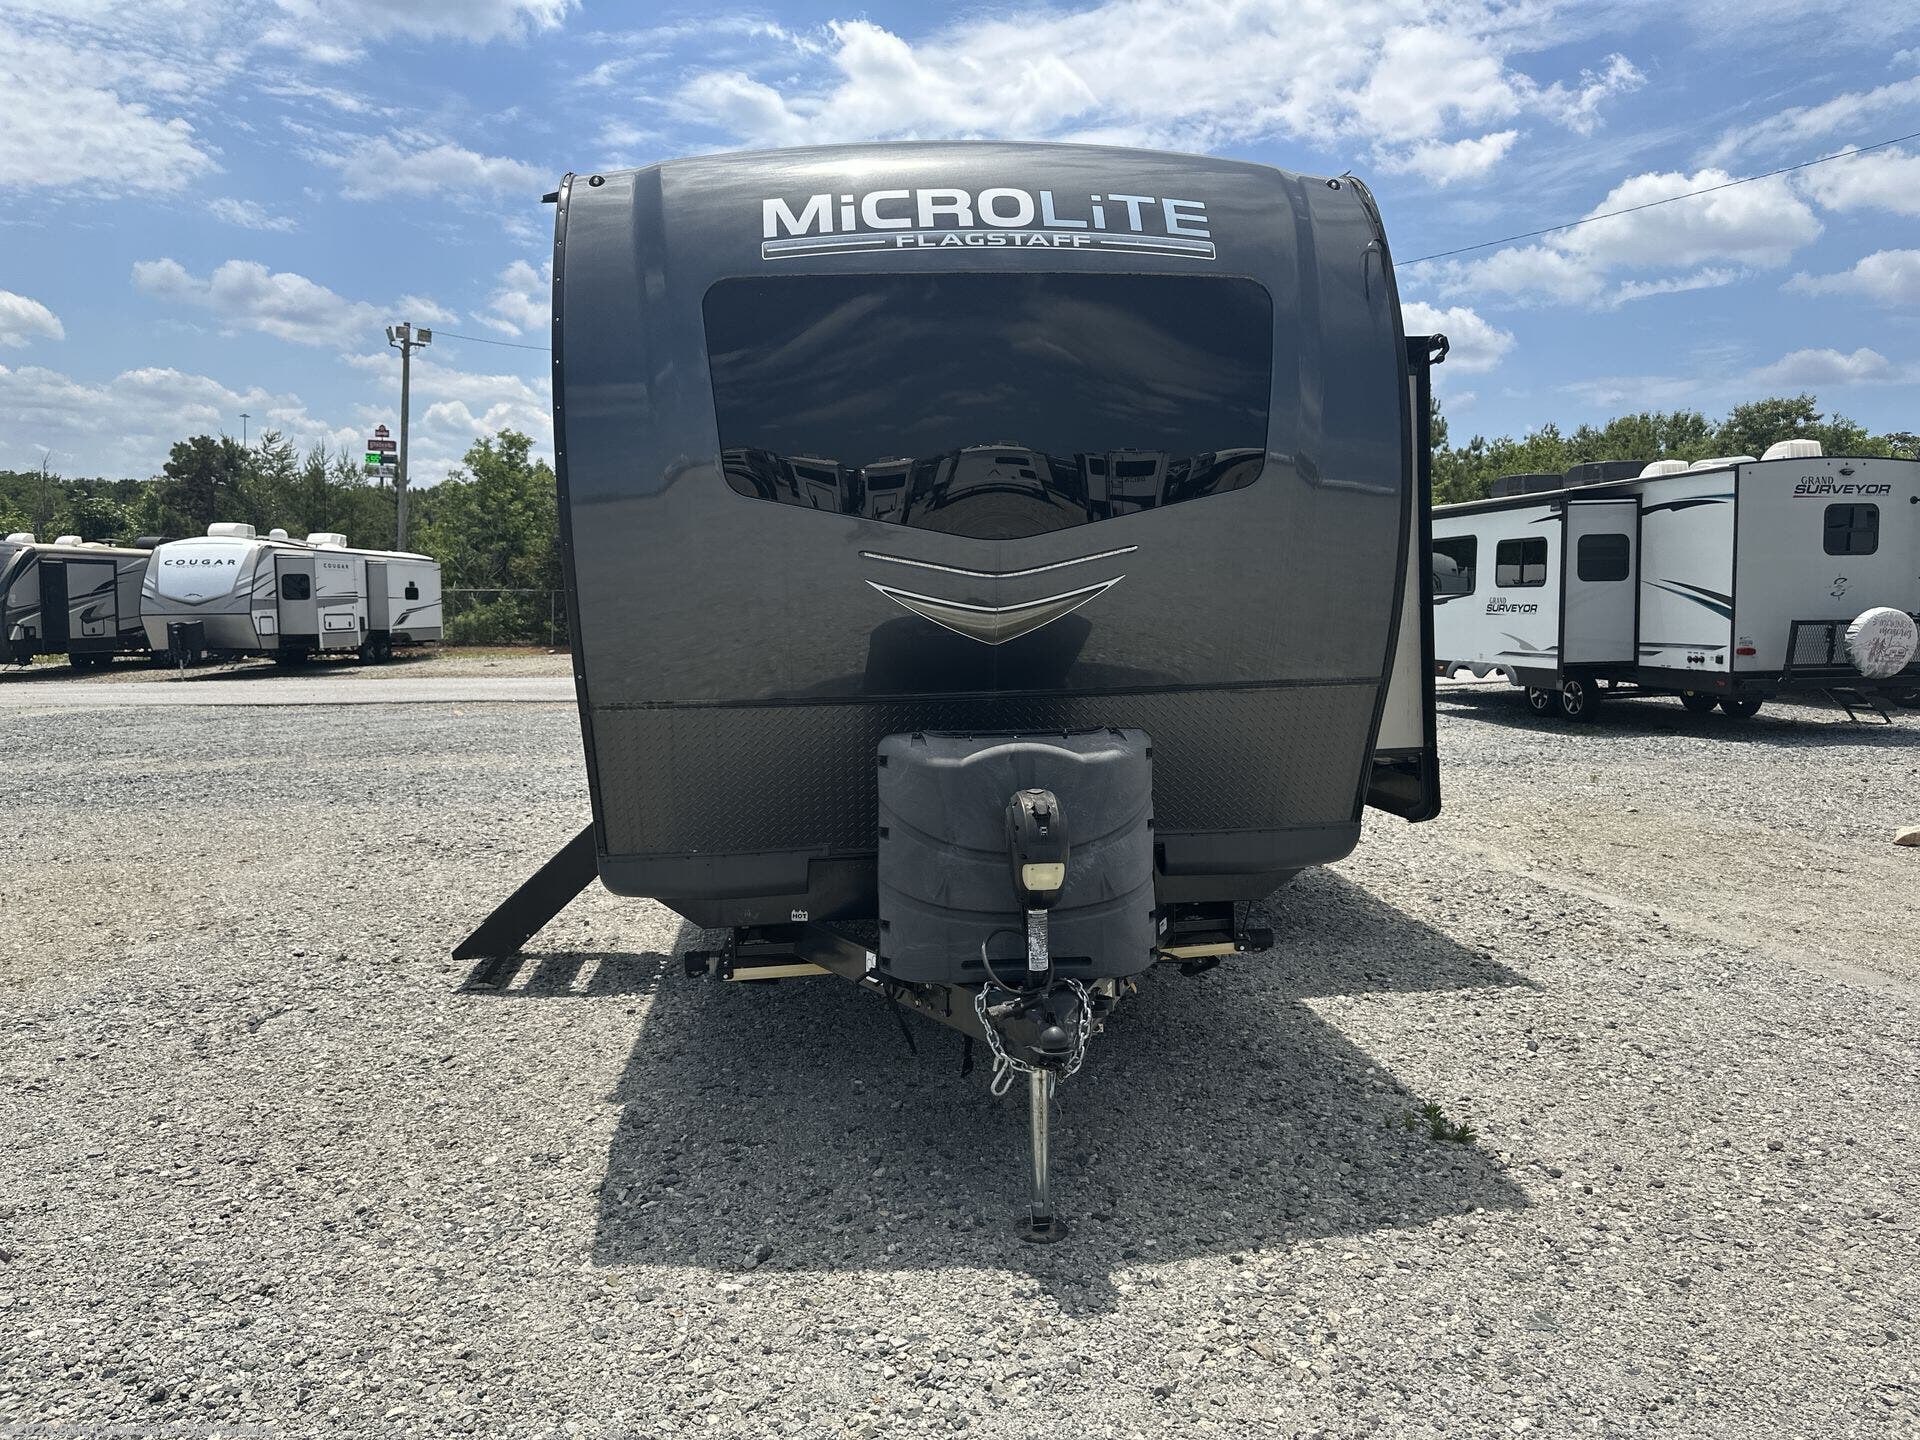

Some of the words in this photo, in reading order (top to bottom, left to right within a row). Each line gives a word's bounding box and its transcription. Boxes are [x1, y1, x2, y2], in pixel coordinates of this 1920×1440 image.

[895, 231, 1092, 248] FLAGSTAFF
[1801, 476, 1834, 485] GRAND
[1795, 484, 1891, 494] SURVEYOR
[1486, 604, 1538, 612] SURVEYOR
